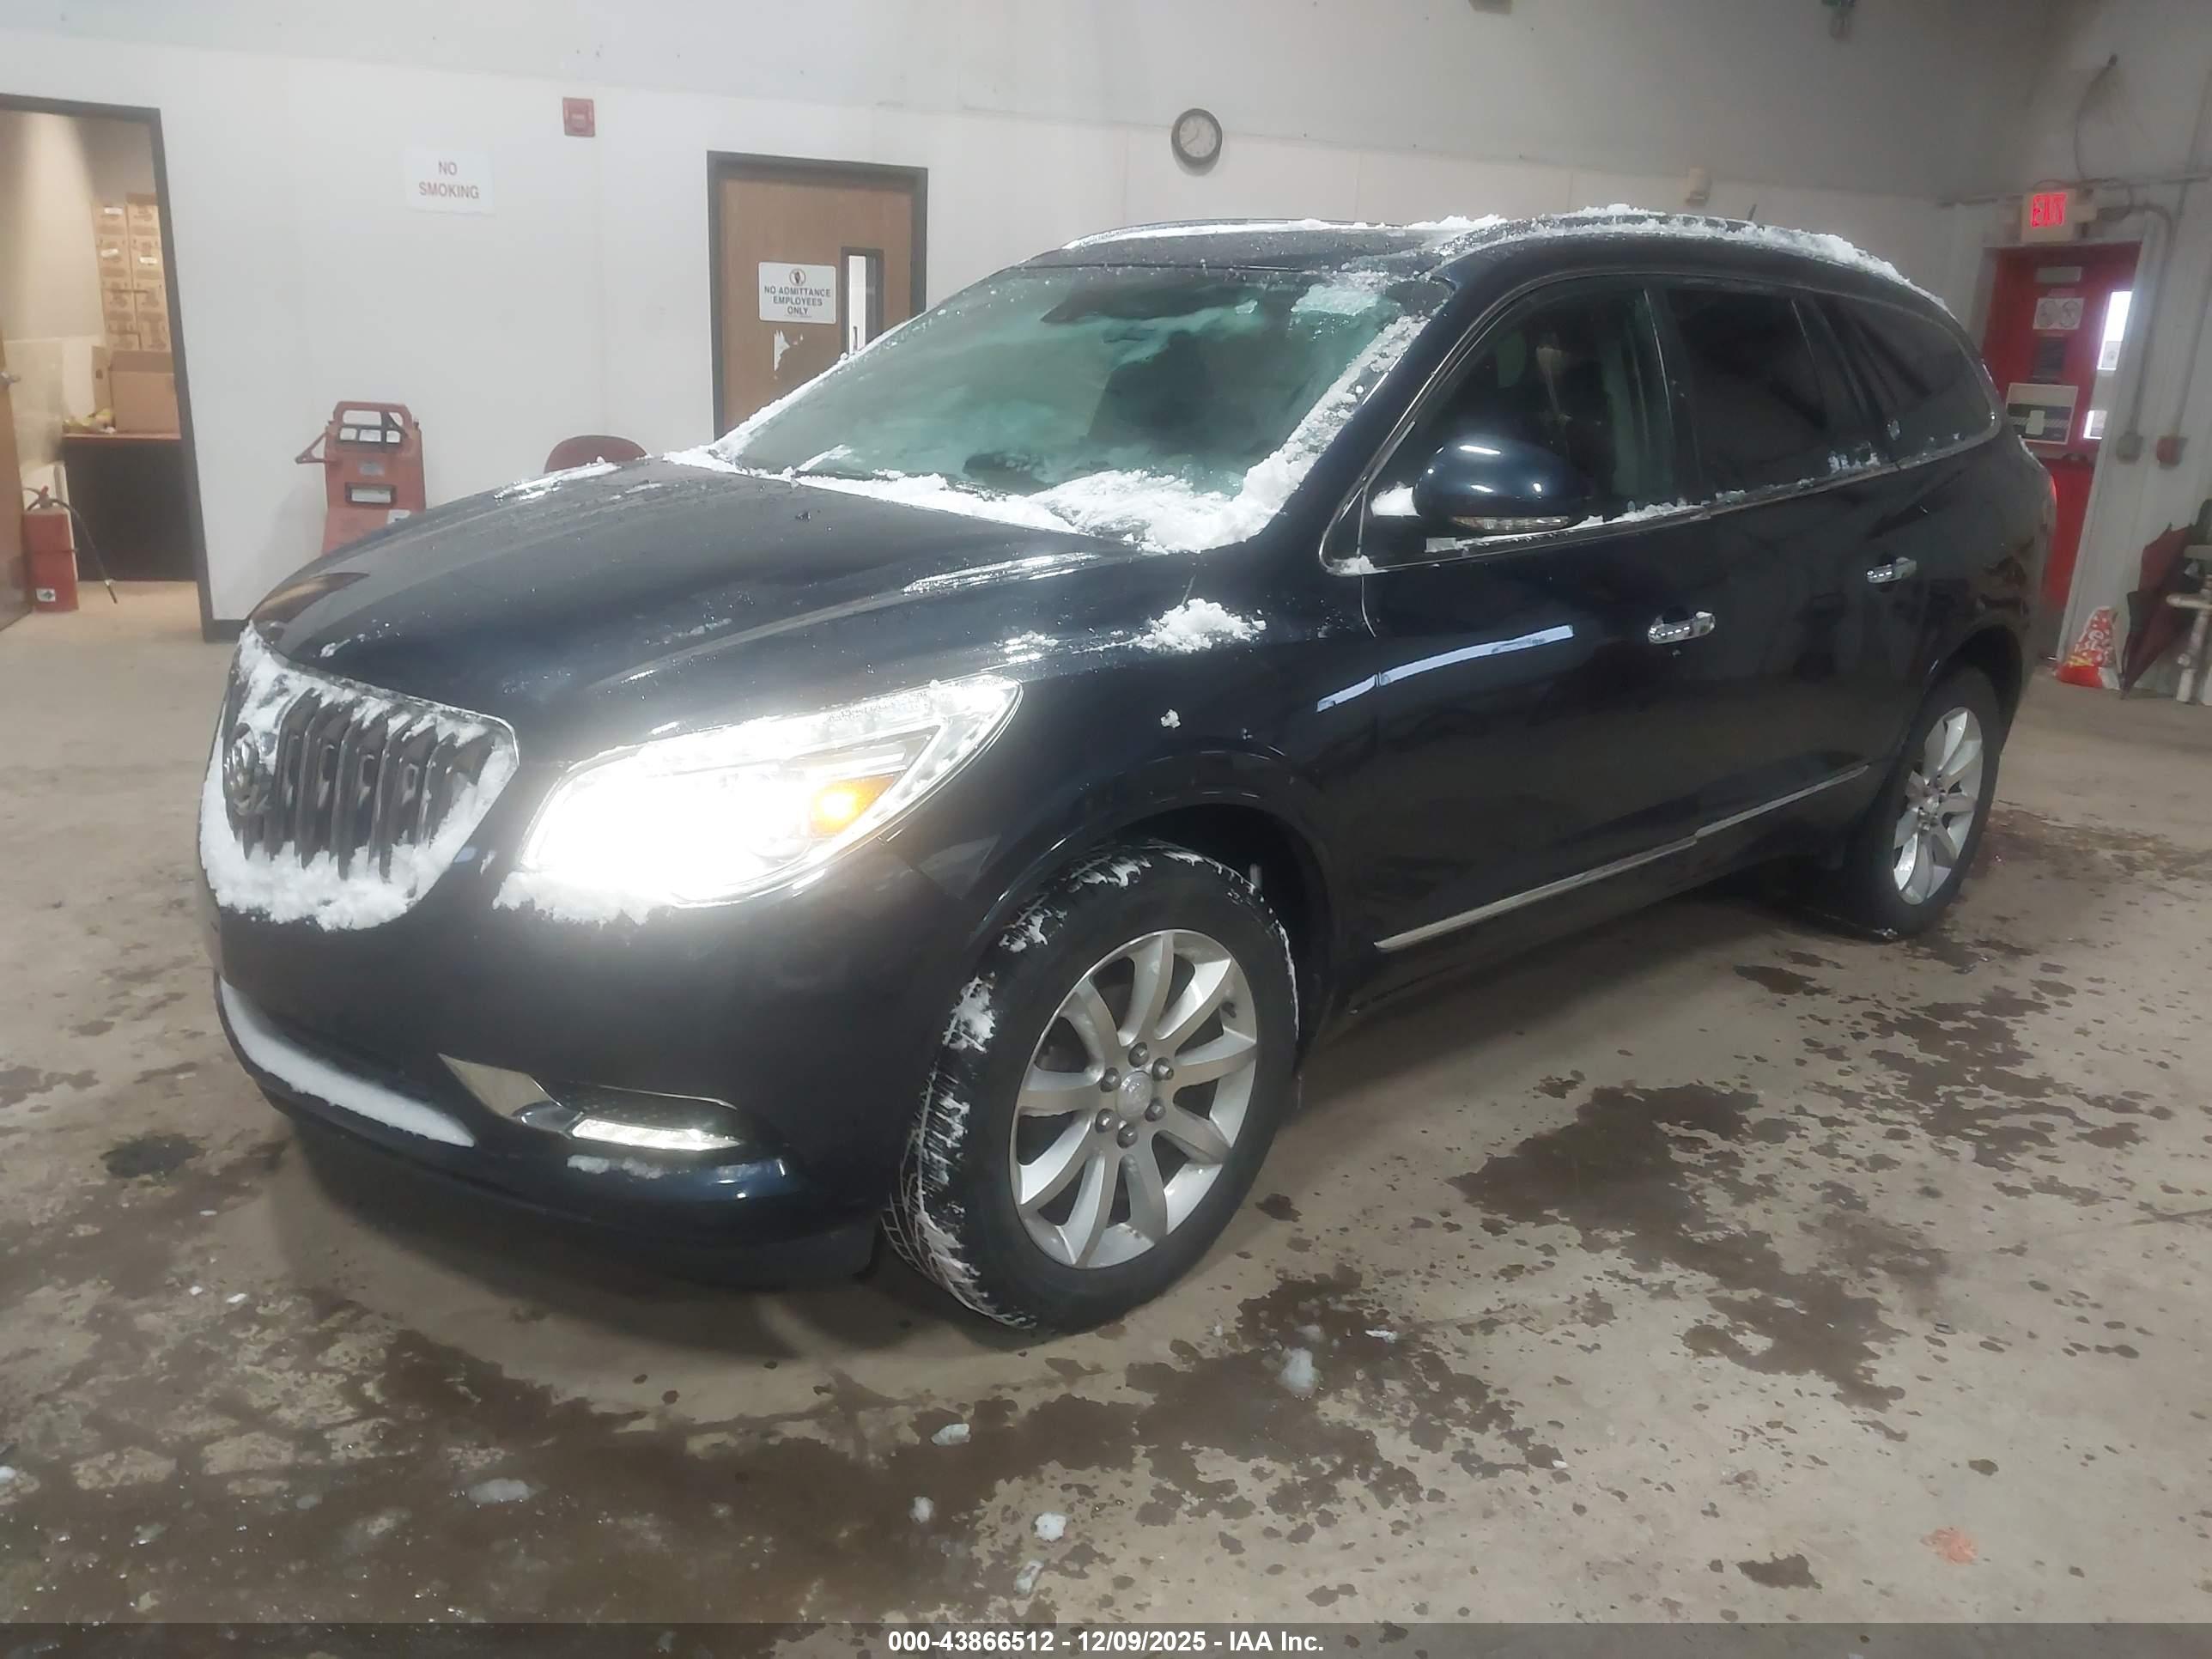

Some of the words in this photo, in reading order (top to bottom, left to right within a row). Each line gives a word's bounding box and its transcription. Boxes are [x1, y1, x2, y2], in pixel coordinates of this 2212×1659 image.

[438, 161, 458, 176] NO
[418, 181, 480, 199] SMOKING
[764, 286, 776, 295] NO
[779, 287, 831, 298] ADMITTANCE
[773, 296, 823, 307] EMPLOYEES
[787, 306, 809, 316] ONLY
